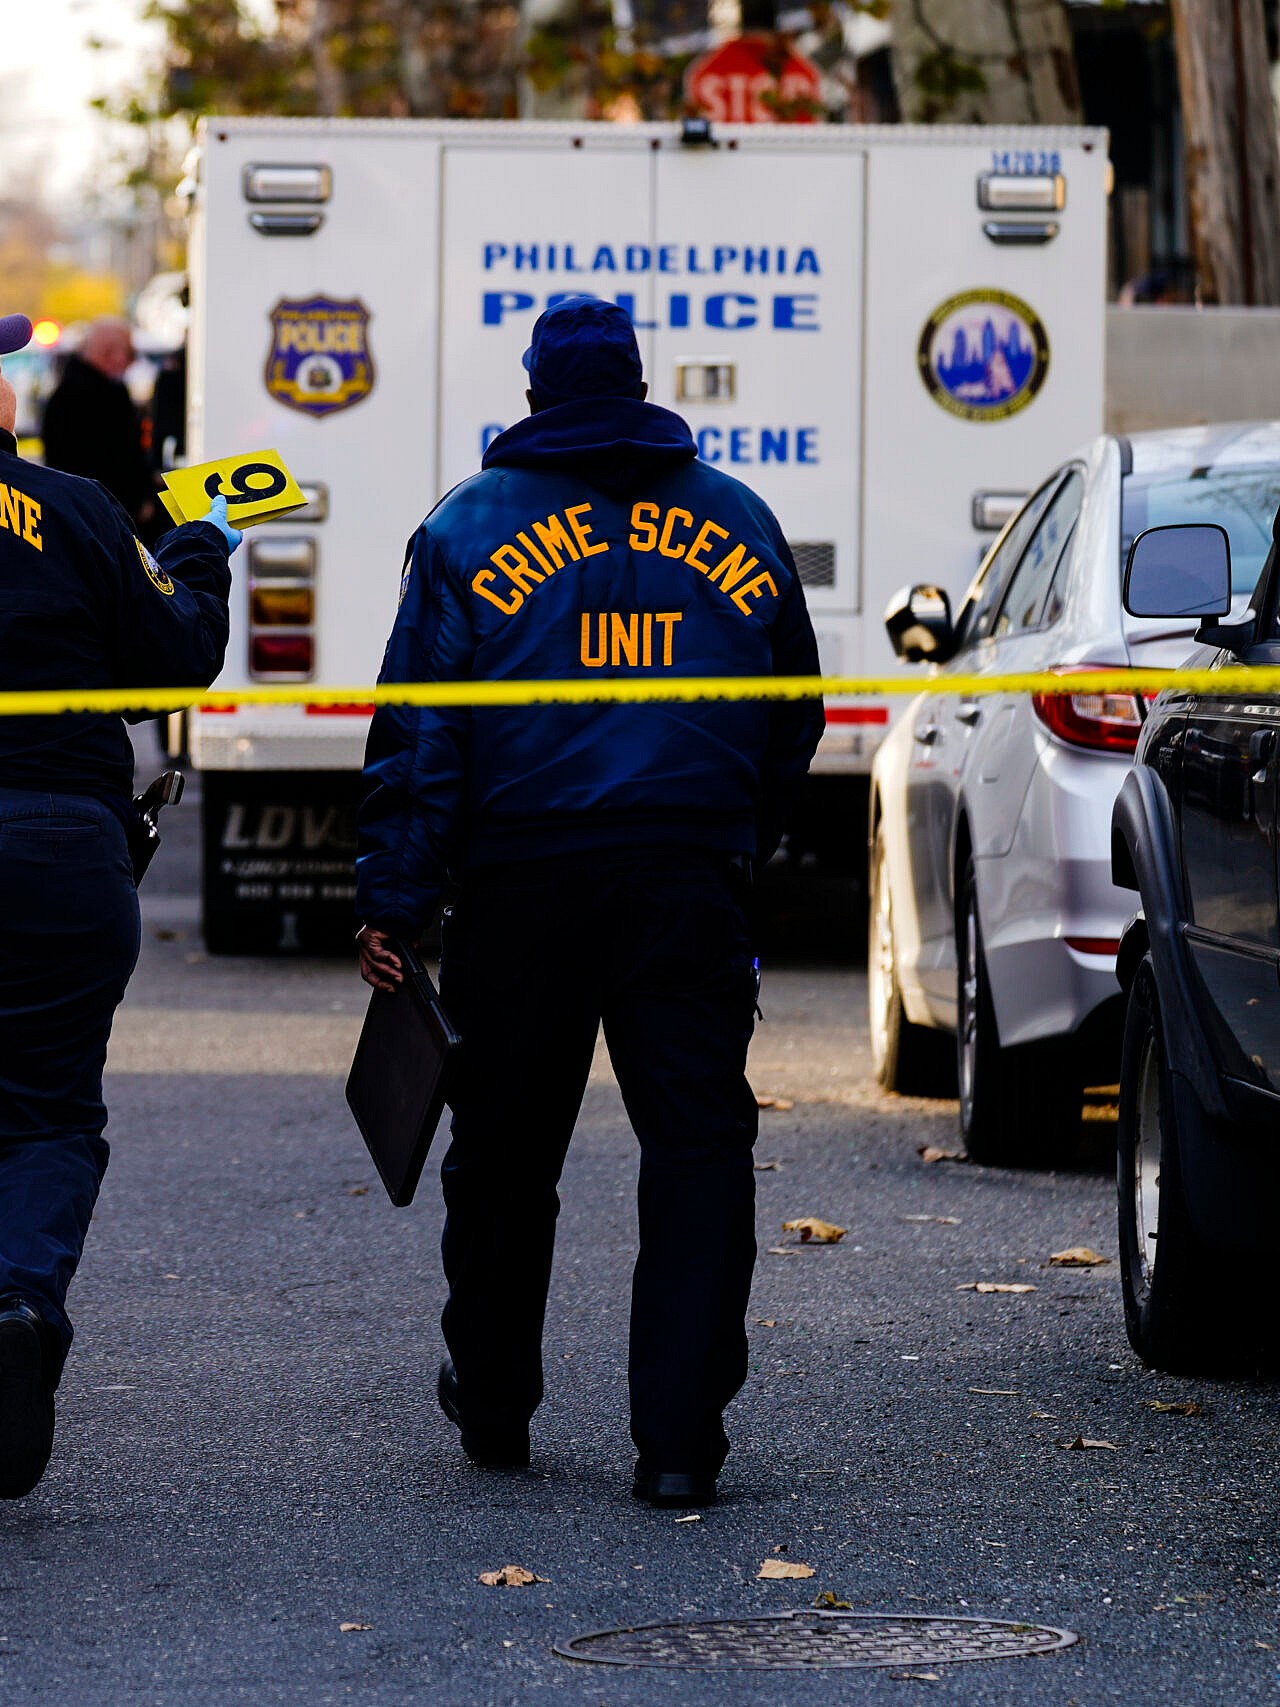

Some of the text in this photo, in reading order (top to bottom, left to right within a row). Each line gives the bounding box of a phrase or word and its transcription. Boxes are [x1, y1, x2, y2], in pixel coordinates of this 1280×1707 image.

[483, 243, 821, 275] PHILADELPHIA
[482, 290, 821, 331] PLICE
[695, 425, 819, 464] CENE
[472, 502, 778, 616] CRIME SCENE
[580, 612, 683, 667] UNIT
